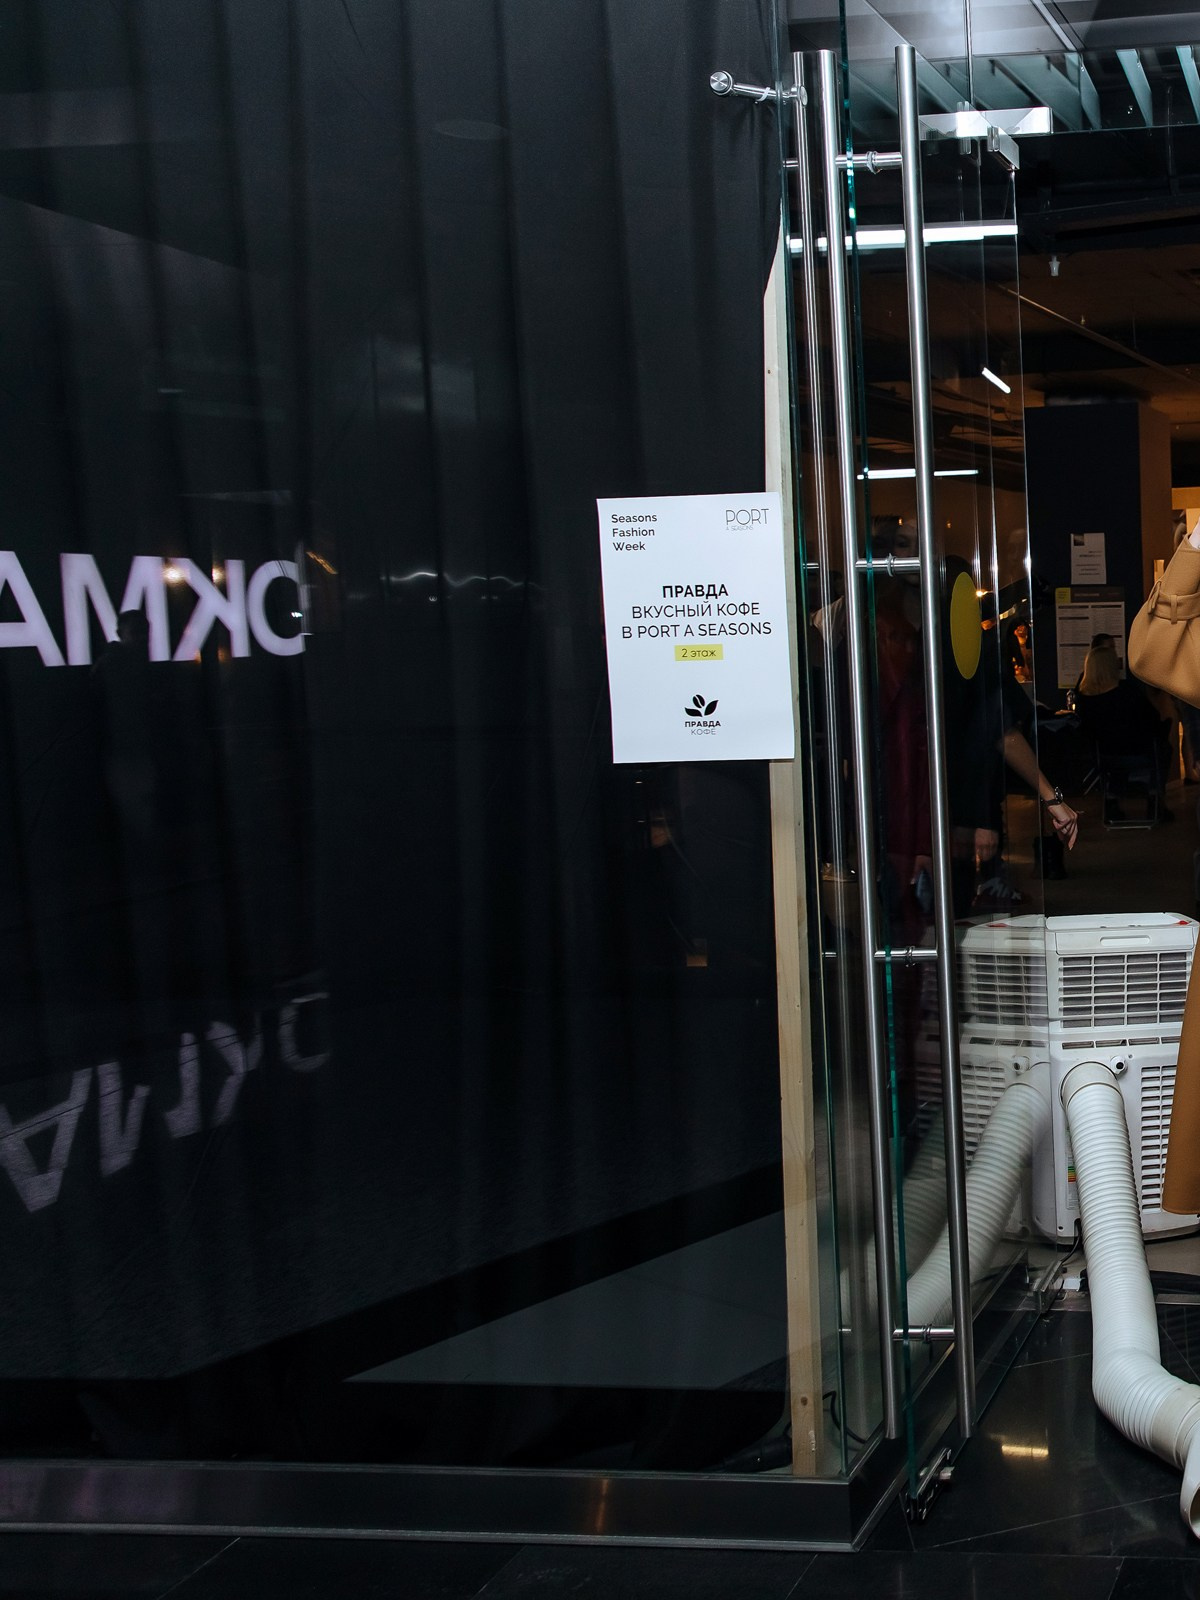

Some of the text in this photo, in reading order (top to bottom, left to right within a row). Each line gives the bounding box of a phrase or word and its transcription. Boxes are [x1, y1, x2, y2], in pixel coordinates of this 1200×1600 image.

[611, 513, 658, 524] Seasons
[725, 508, 770, 525] PORT
[612, 526, 656, 538] Fashion
[612, 541, 646, 552] Week
[662, 583, 729, 600] ПРАВДА
[631, 600, 761, 619] ВКУСНЫЙ КОФЕ
[637, 624, 680, 639] PORT
[698, 621, 772, 637] SEASONS
[681, 648, 717, 658] 2 этаж
[684, 720, 722, 728] ПРАВДА
[690, 728, 716, 736] КОФЕ
